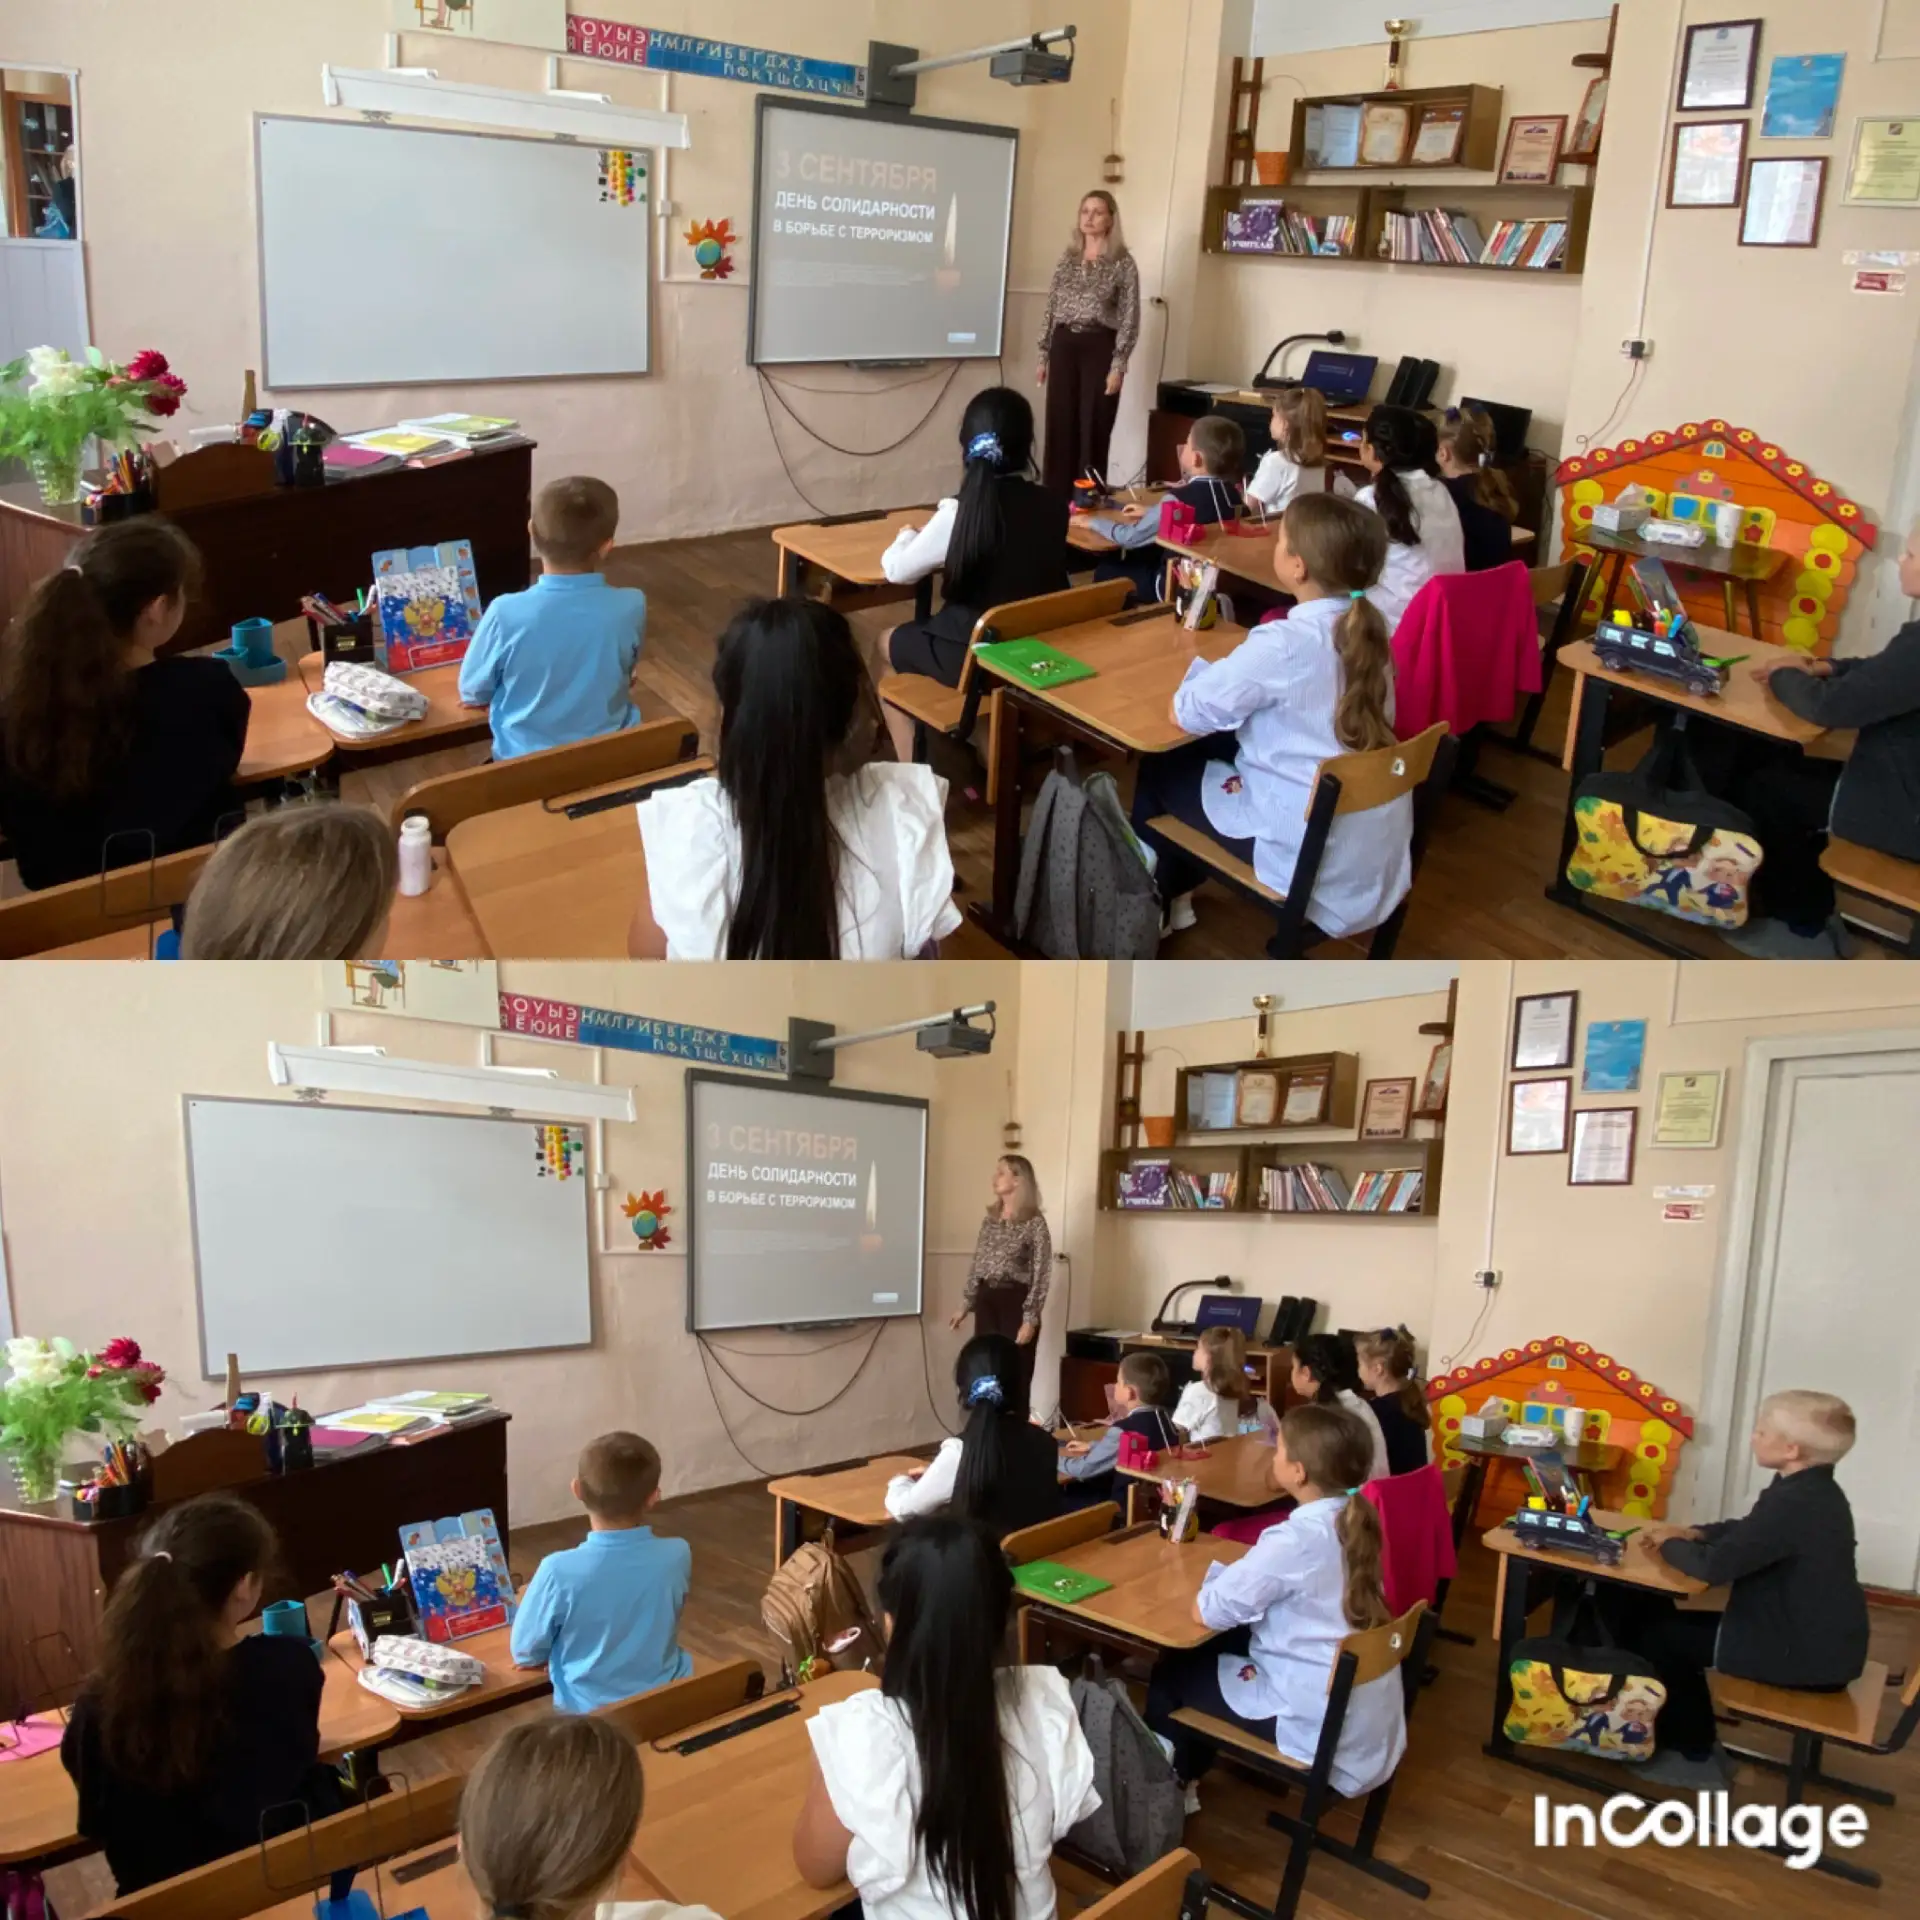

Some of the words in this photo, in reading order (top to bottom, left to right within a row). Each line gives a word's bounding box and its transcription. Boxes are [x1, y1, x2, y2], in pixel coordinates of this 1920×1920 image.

[776, 150, 791, 179] 3
[800, 153, 937, 193] СЕНТЯБРЯ
[775, 190, 818, 211] ДЕНЬ
[821, 195, 935, 220] СОЛИДАРНОСТИ
[773, 219, 782, 233] В
[785, 220, 835, 238] БОРЬБЕ
[838, 225, 847, 238] С
[849, 226, 934, 243] ТЕРРОРИЗМОМ
[707, 1122, 721, 1148] 3
[729, 1125, 858, 1161] СЕНТЯБРЯ
[708, 1162, 748, 1180] ДЕНЬ
[751, 1166, 857, 1187] СОЛИДАРНОСТИ
[707, 1189, 716, 1203] В
[718, 1190, 766, 1206] БОРЬБЕ
[768, 1194, 776, 1206] С
[779, 1194, 857, 1210] ТЕРРОРИЗМОМ
